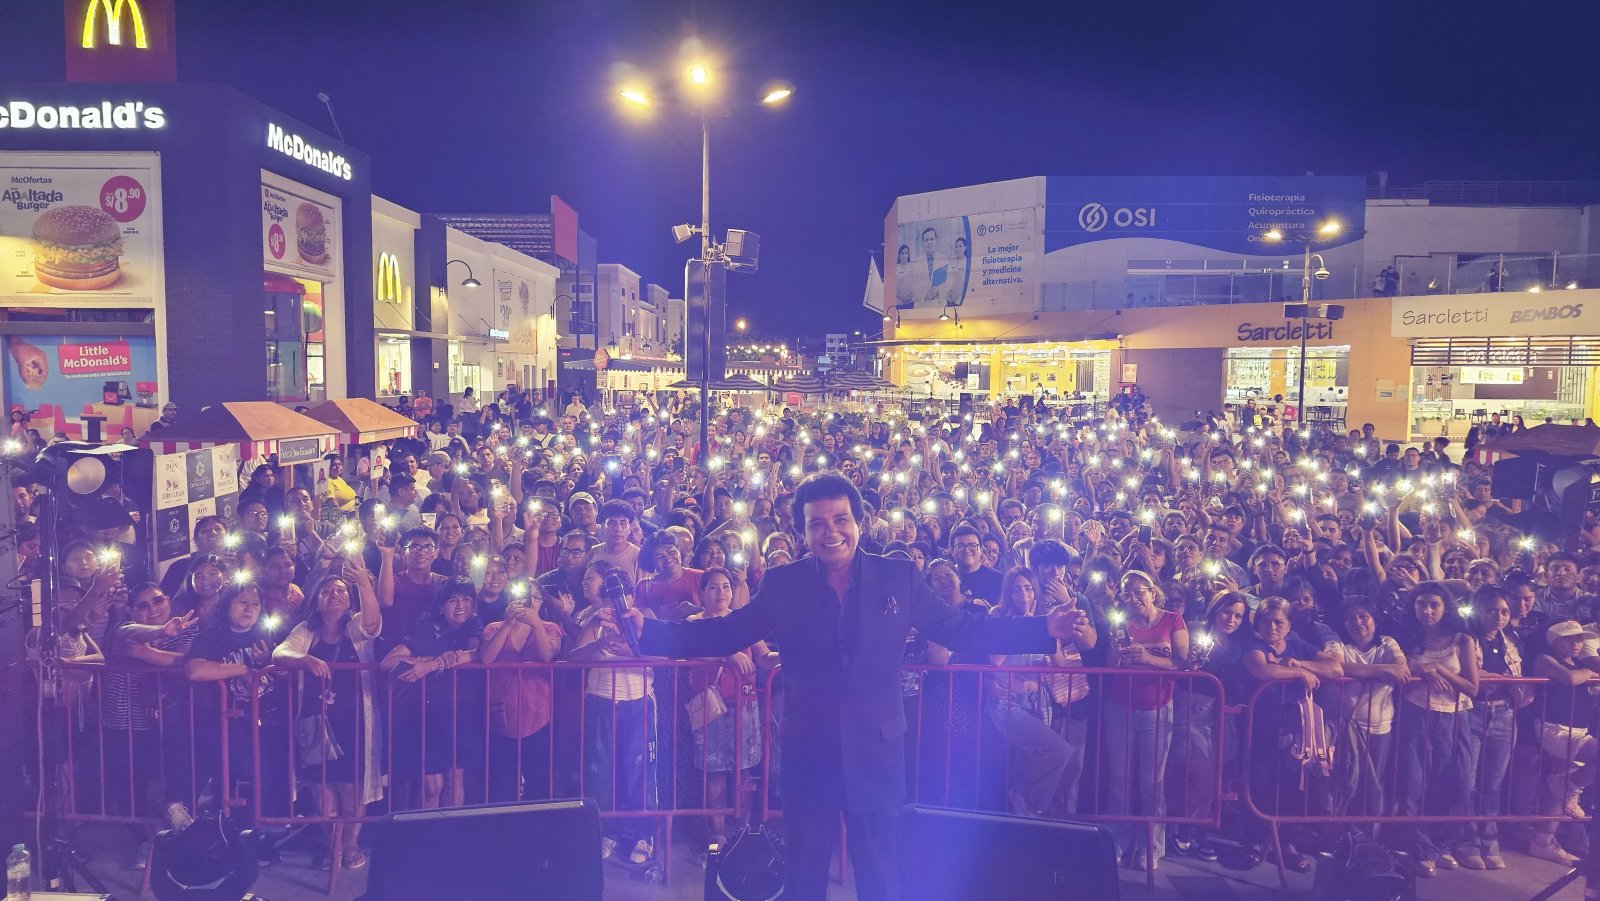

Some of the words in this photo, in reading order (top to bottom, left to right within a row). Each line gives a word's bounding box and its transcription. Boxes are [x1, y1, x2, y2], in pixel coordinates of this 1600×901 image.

[267, 122, 352, 180] McDonald's
[11, 176, 52, 184] McOfertas
[2, 188, 63, 204] Apaltada
[1248, 193, 1305, 203] Fisioterapia
[17, 201, 49, 212] Burger
[1248, 206, 1315, 217] Quiropráctica
[1113, 208, 1156, 227] OSI
[988, 224, 1003, 233] OSI
[1248, 221, 1305, 230] Acupuntura
[997, 244, 1020, 253] mejor
[982, 254, 1022, 264] fisioterapia
[982, 268, 987, 276] y
[988, 266, 1021, 274] medicina
[982, 276, 1023, 285] alternativa.
[1402, 308, 1489, 326] Sarcletti
[1509, 304, 1584, 324] BEMBOS
[1237, 321, 1333, 341] Sarcletti
[79, 345, 109, 356] Little
[63, 355, 128, 368] McDonald's
